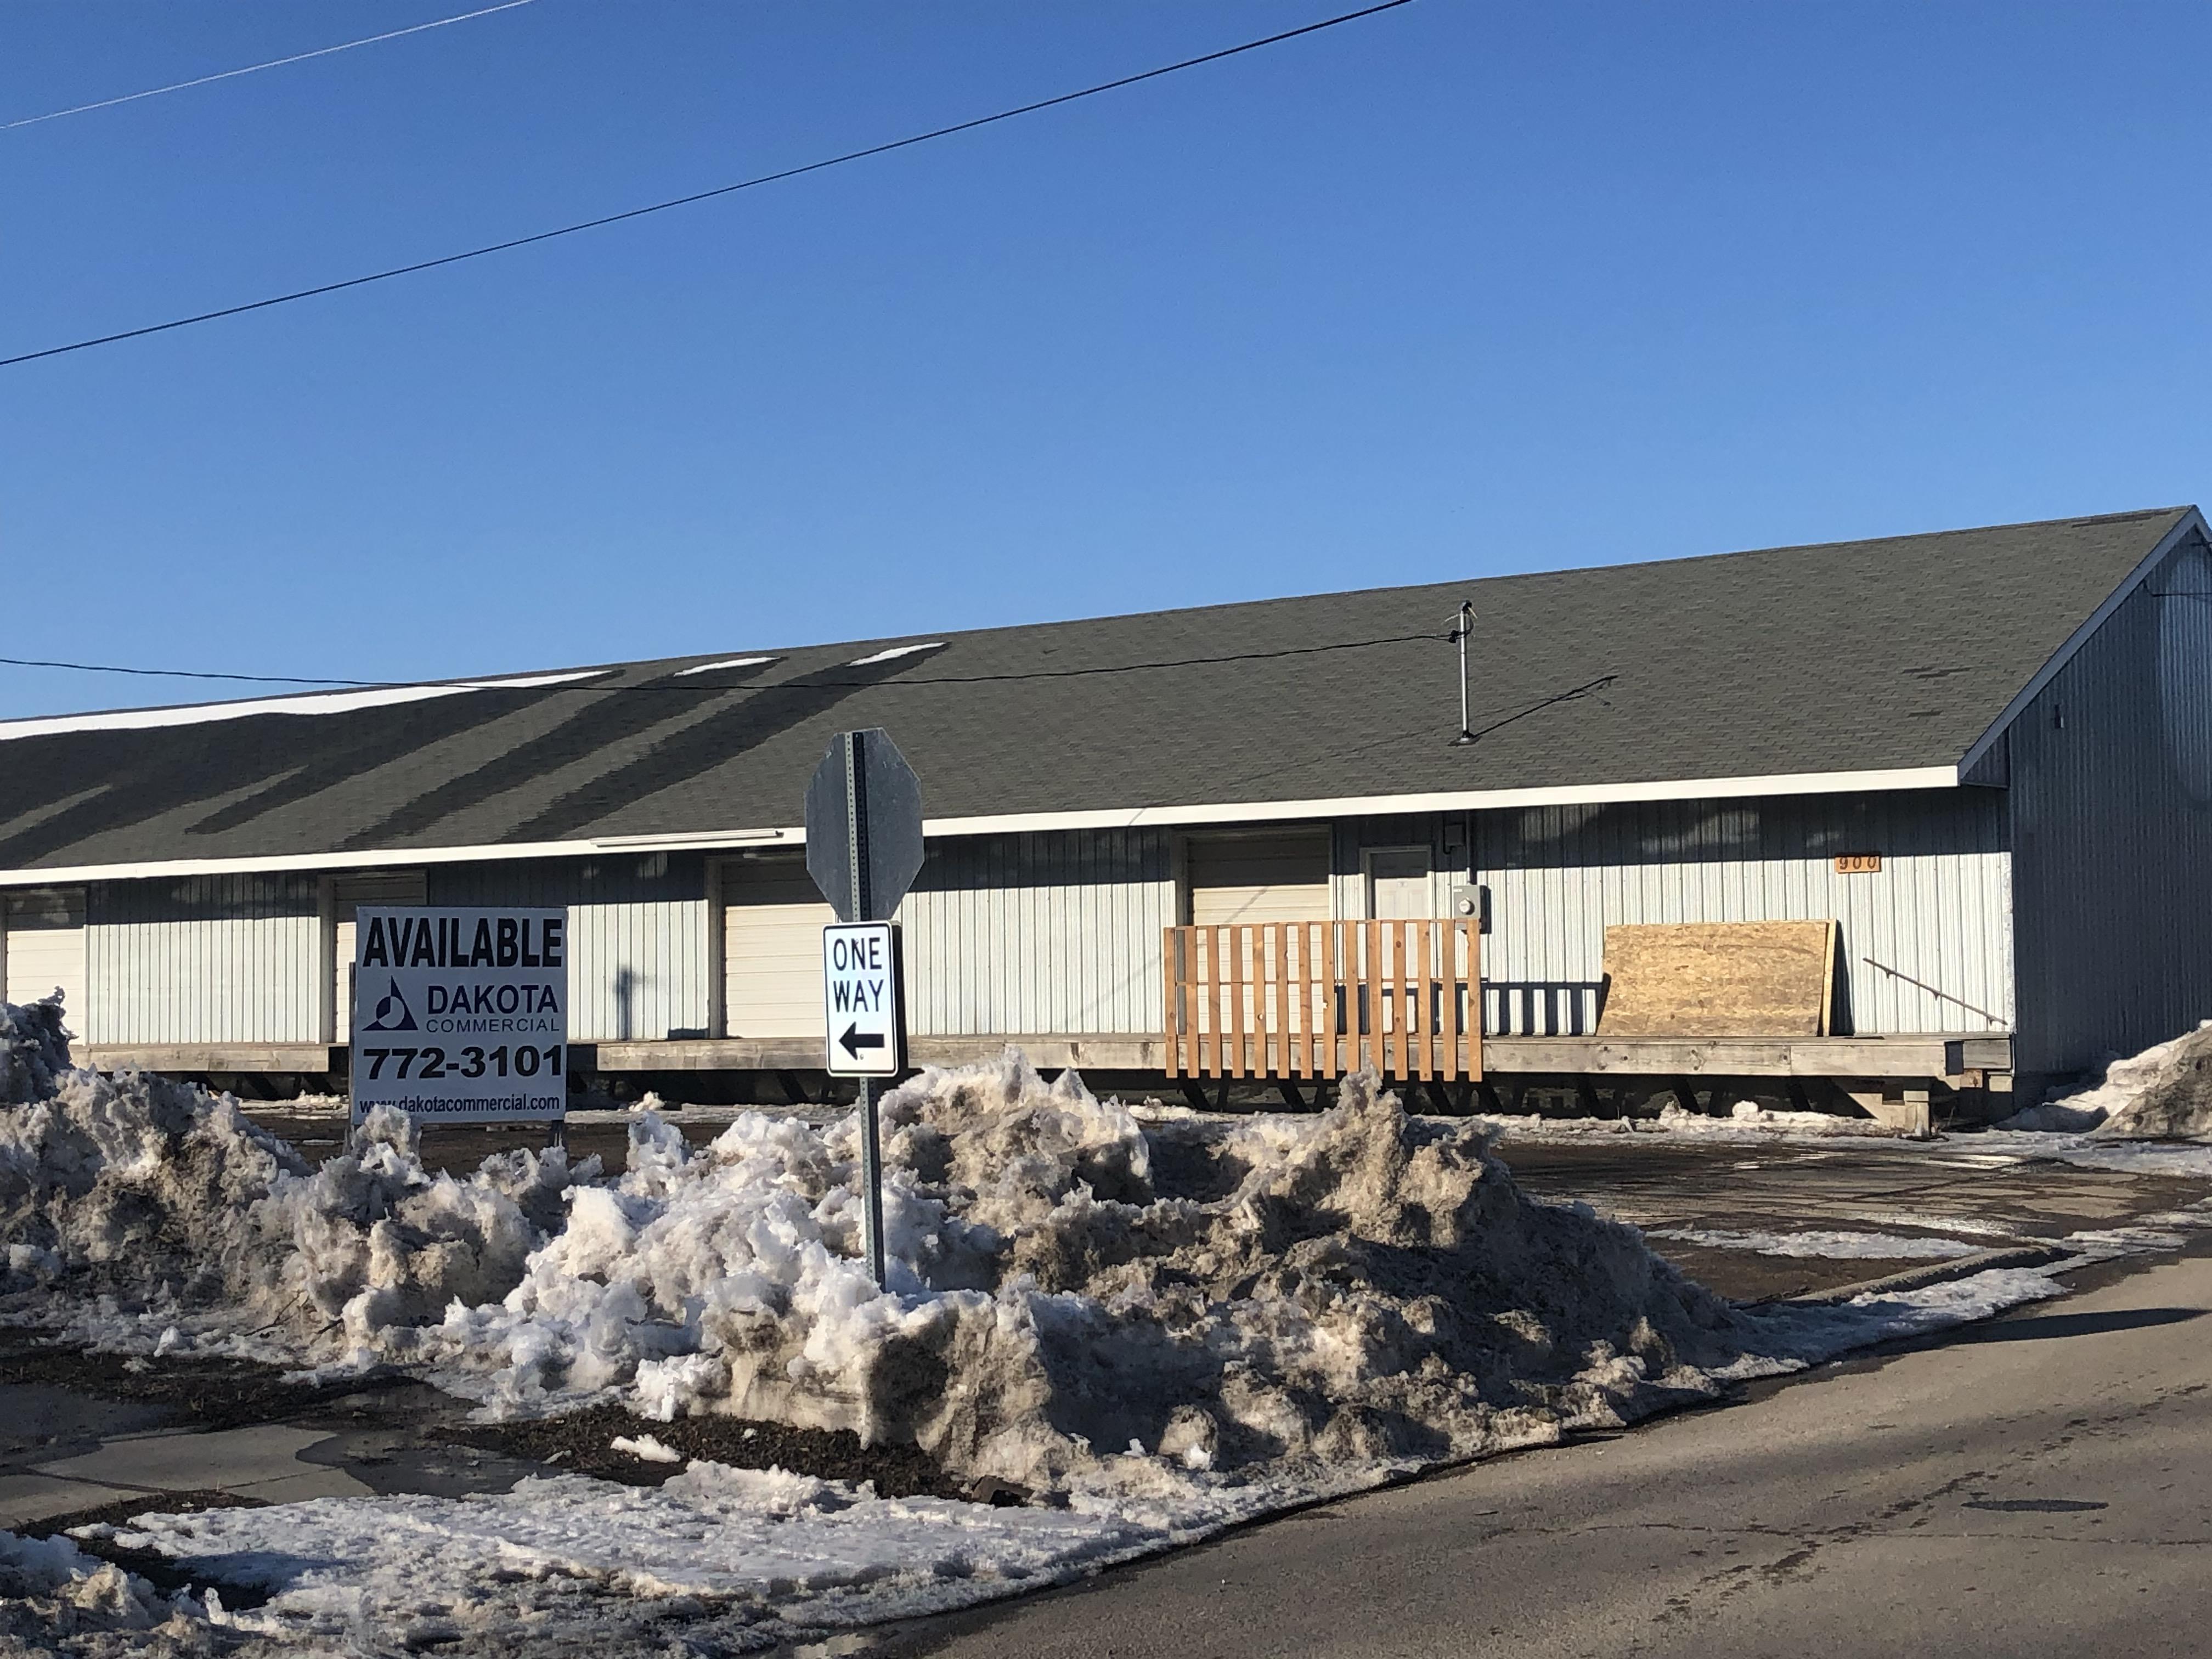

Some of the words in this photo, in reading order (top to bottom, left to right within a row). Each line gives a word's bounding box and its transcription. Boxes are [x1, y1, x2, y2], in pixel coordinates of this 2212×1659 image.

[1839, 855, 1877, 870] 900
[363, 917, 562, 968] AVAILABLE
[833, 936, 883, 971] ONE
[427, 984, 559, 1014] DAKOTA
[833, 979, 884, 1013] WAY
[426, 1018, 560, 1033] COMMERCIAL
[363, 1045, 562, 1080] 772-3101
